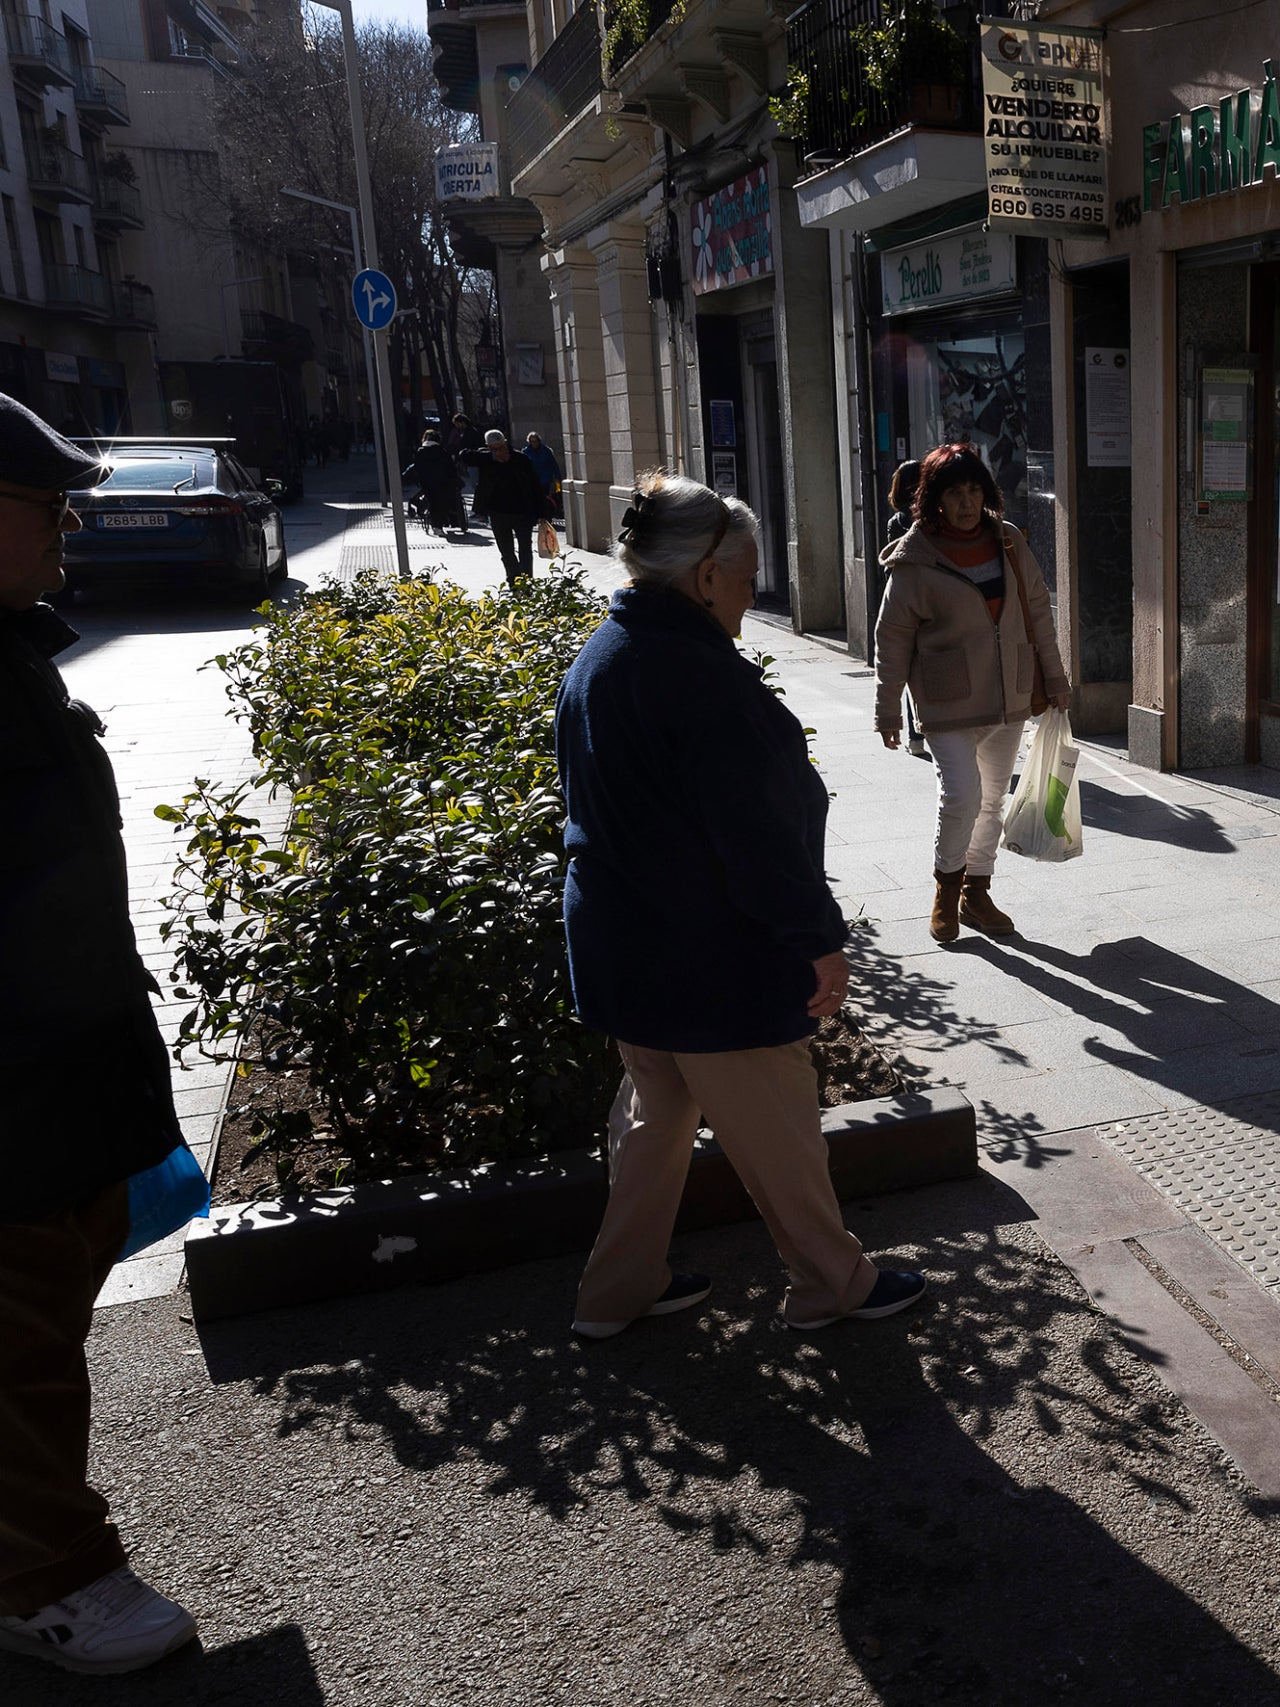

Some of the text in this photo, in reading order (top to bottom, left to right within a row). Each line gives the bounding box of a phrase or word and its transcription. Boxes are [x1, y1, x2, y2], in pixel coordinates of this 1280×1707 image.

[1011, 78, 1077, 97] ¿QUIERE
[986, 94, 1100, 123] VENDER O
[986, 118, 1101, 145] ALQUILAR
[991, 143, 1099, 162] SU INMUEBLE?
[1012, 168, 1039, 179] DEJE
[1040, 171, 1055, 180] DE
[990, 184, 1104, 203] CITAS CONCERTADAS
[991, 198, 1103, 222] 600 635 495
[1115, 195, 1142, 229] 263
[898, 249, 943, 302] Perelló
[106, 514, 165, 526] 2685 LBB
